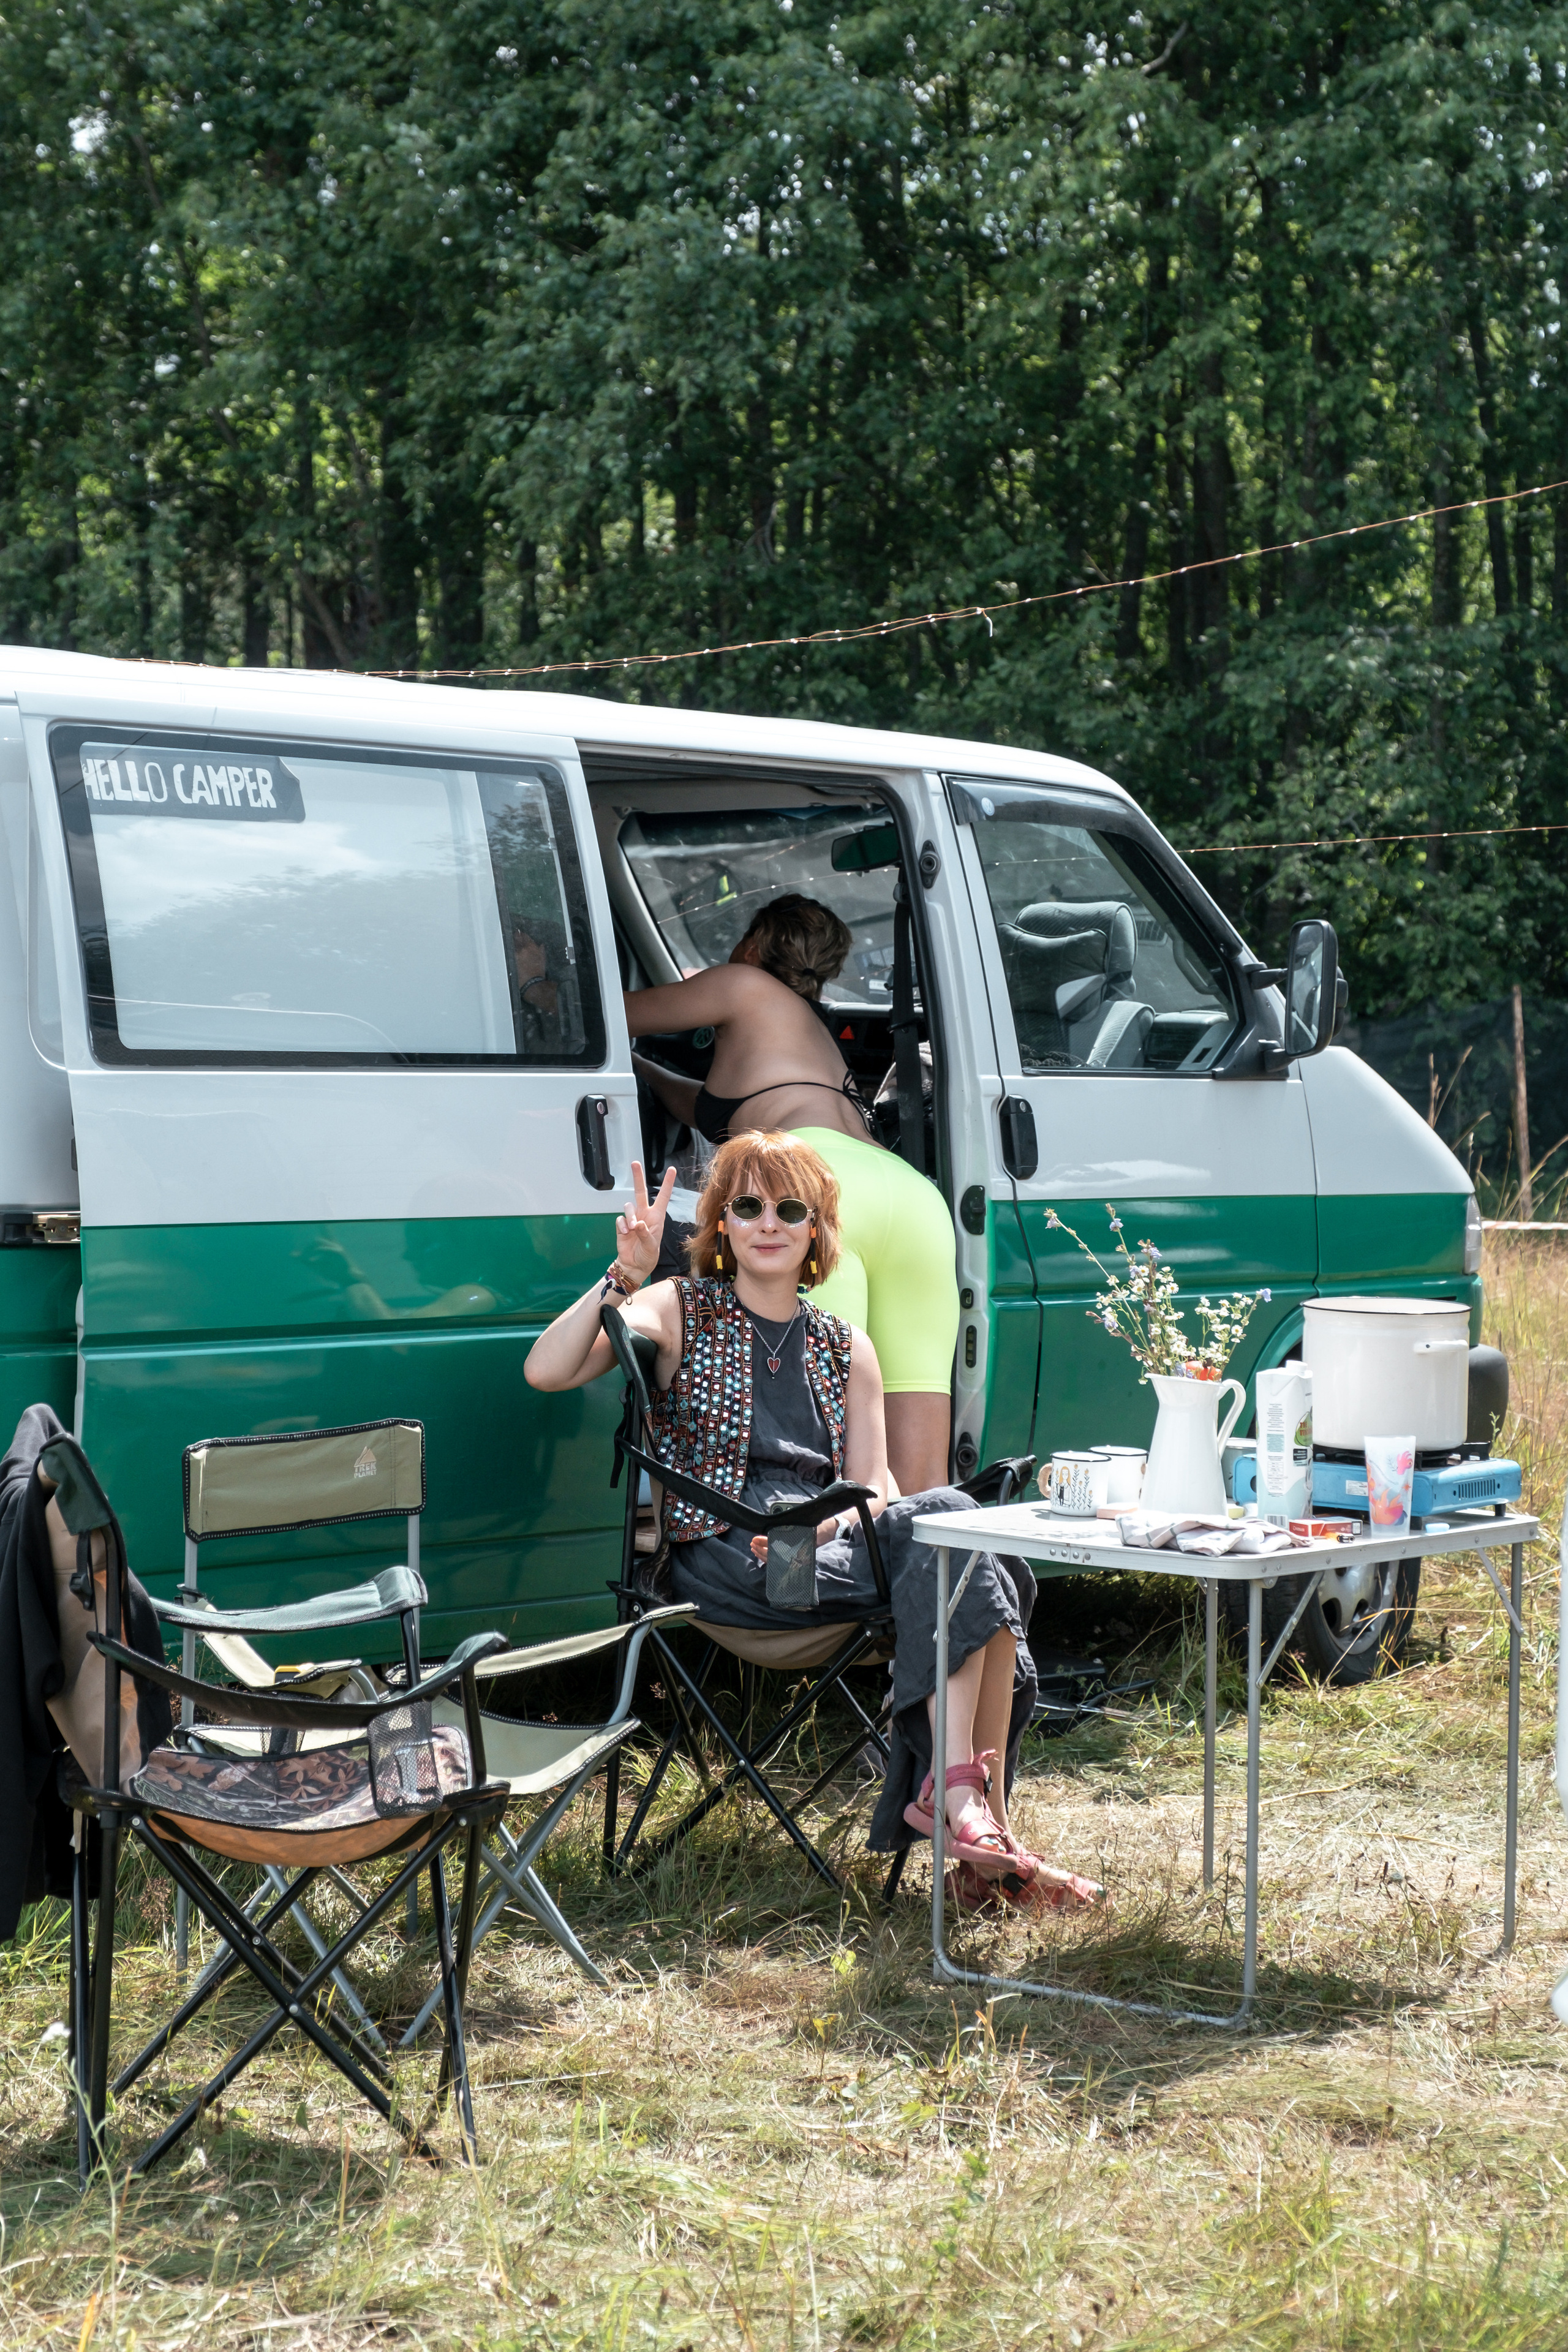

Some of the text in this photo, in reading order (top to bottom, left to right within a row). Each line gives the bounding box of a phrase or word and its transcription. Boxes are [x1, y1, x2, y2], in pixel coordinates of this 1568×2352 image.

[80, 758, 277, 809] HELLO CAMPER
[354, 1462, 377, 1472] TREK
[354, 1469, 377, 1479] PLANET
